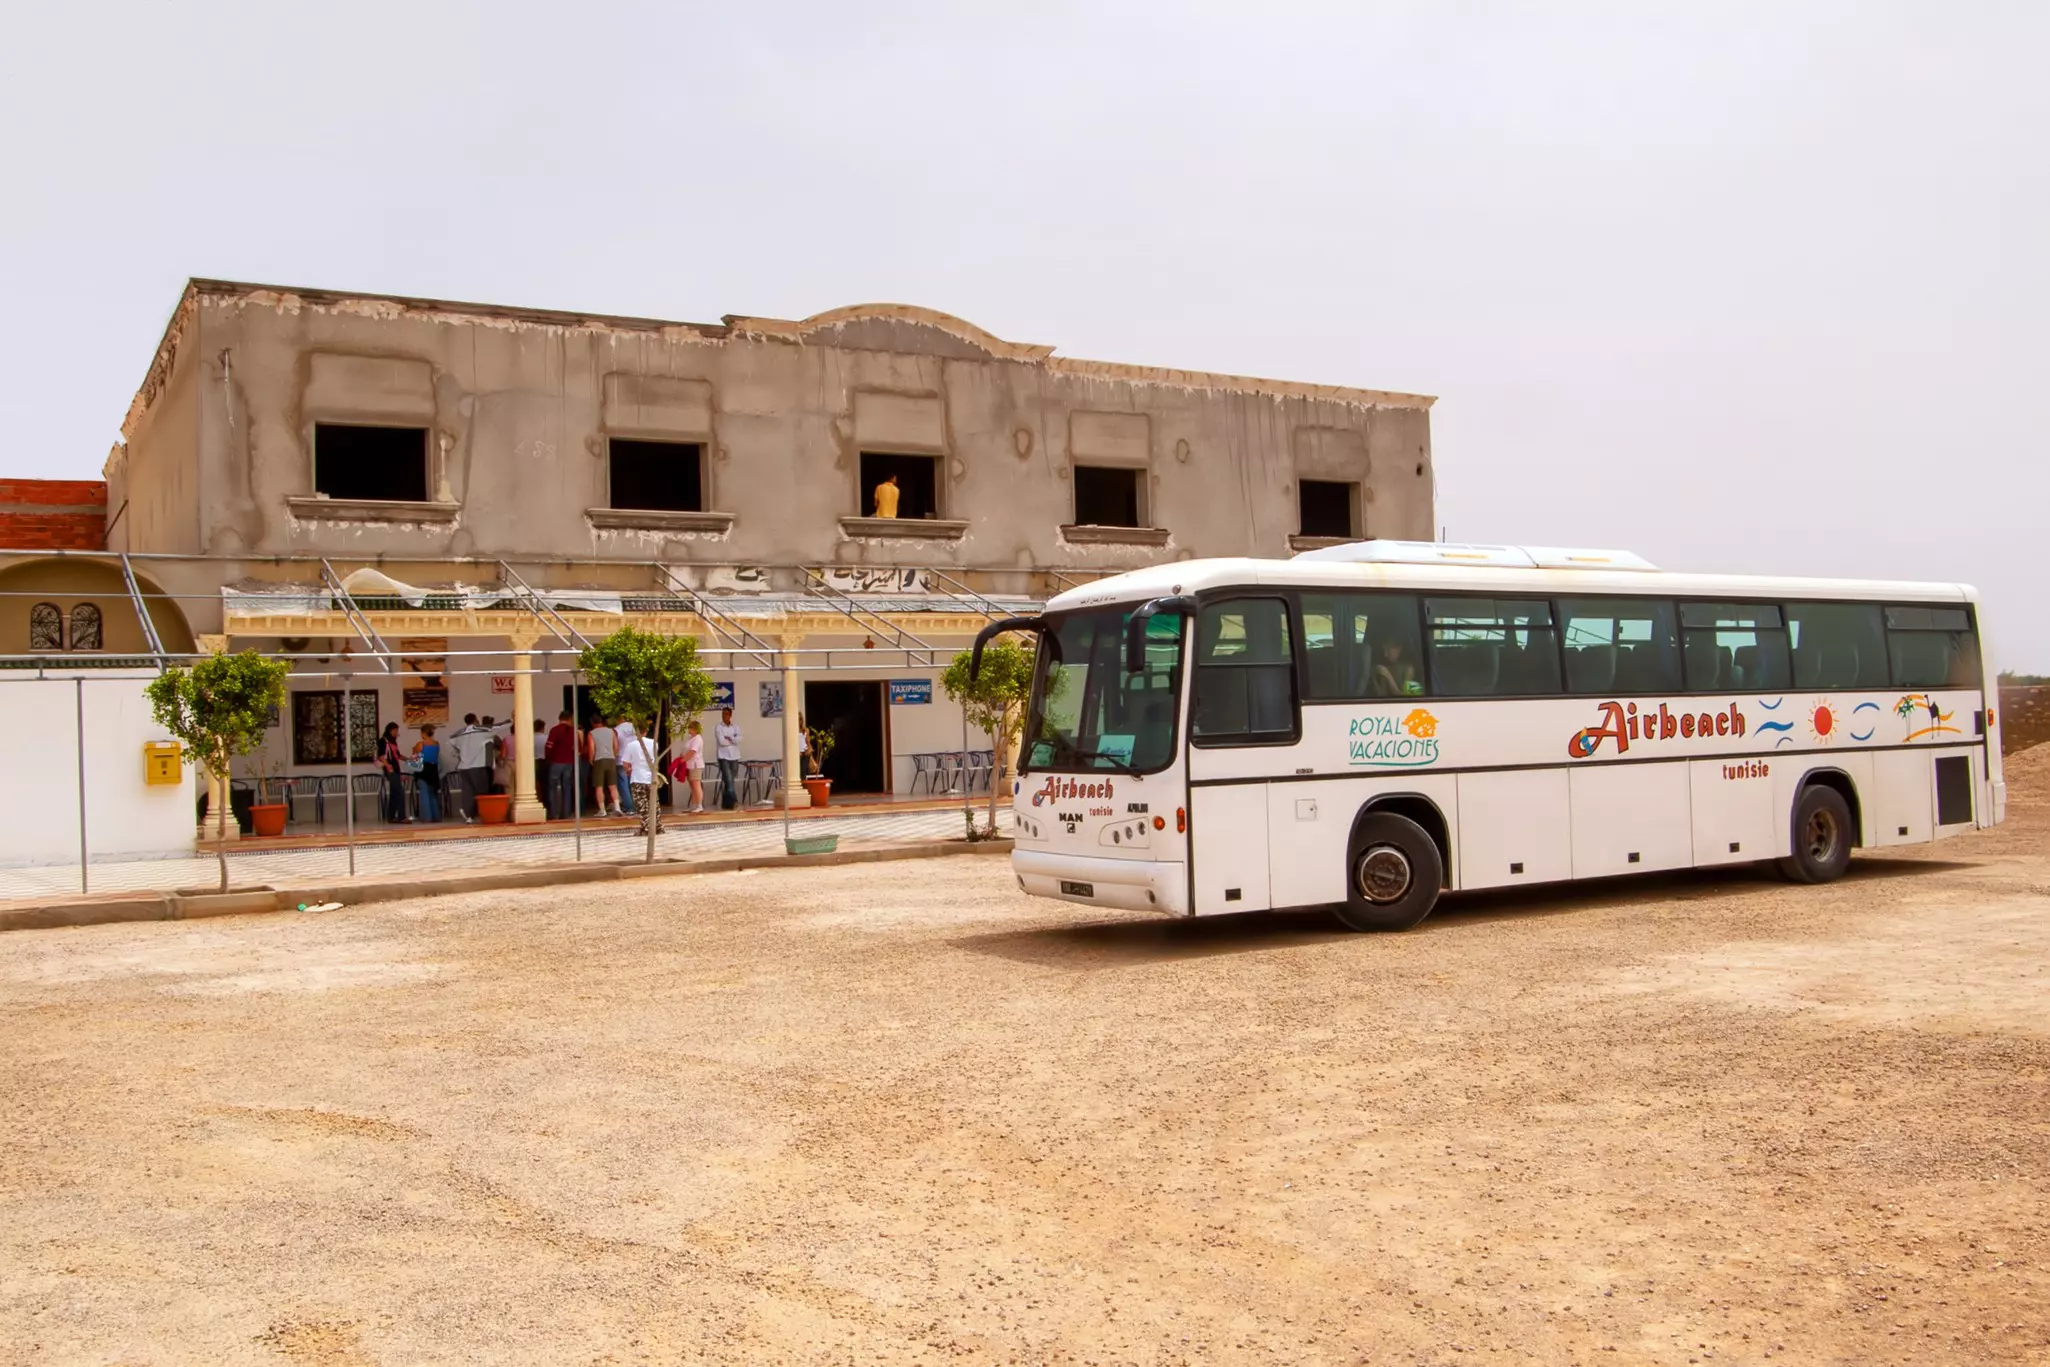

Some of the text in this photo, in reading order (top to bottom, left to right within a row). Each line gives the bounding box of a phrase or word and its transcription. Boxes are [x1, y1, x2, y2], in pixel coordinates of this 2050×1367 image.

[890, 684, 931, 693] TAXIPHONE
[1349, 716, 1402, 736] ROYAL
[1568, 701, 1746, 758] Airbeach
[1349, 739, 1439, 766] VACACIONES
[1722, 760, 1769, 780] tunisie
[1032, 776, 1114, 807] Airbeach
[1059, 813, 1083, 822] MAN
[1089, 806, 1113, 817] tunisie
